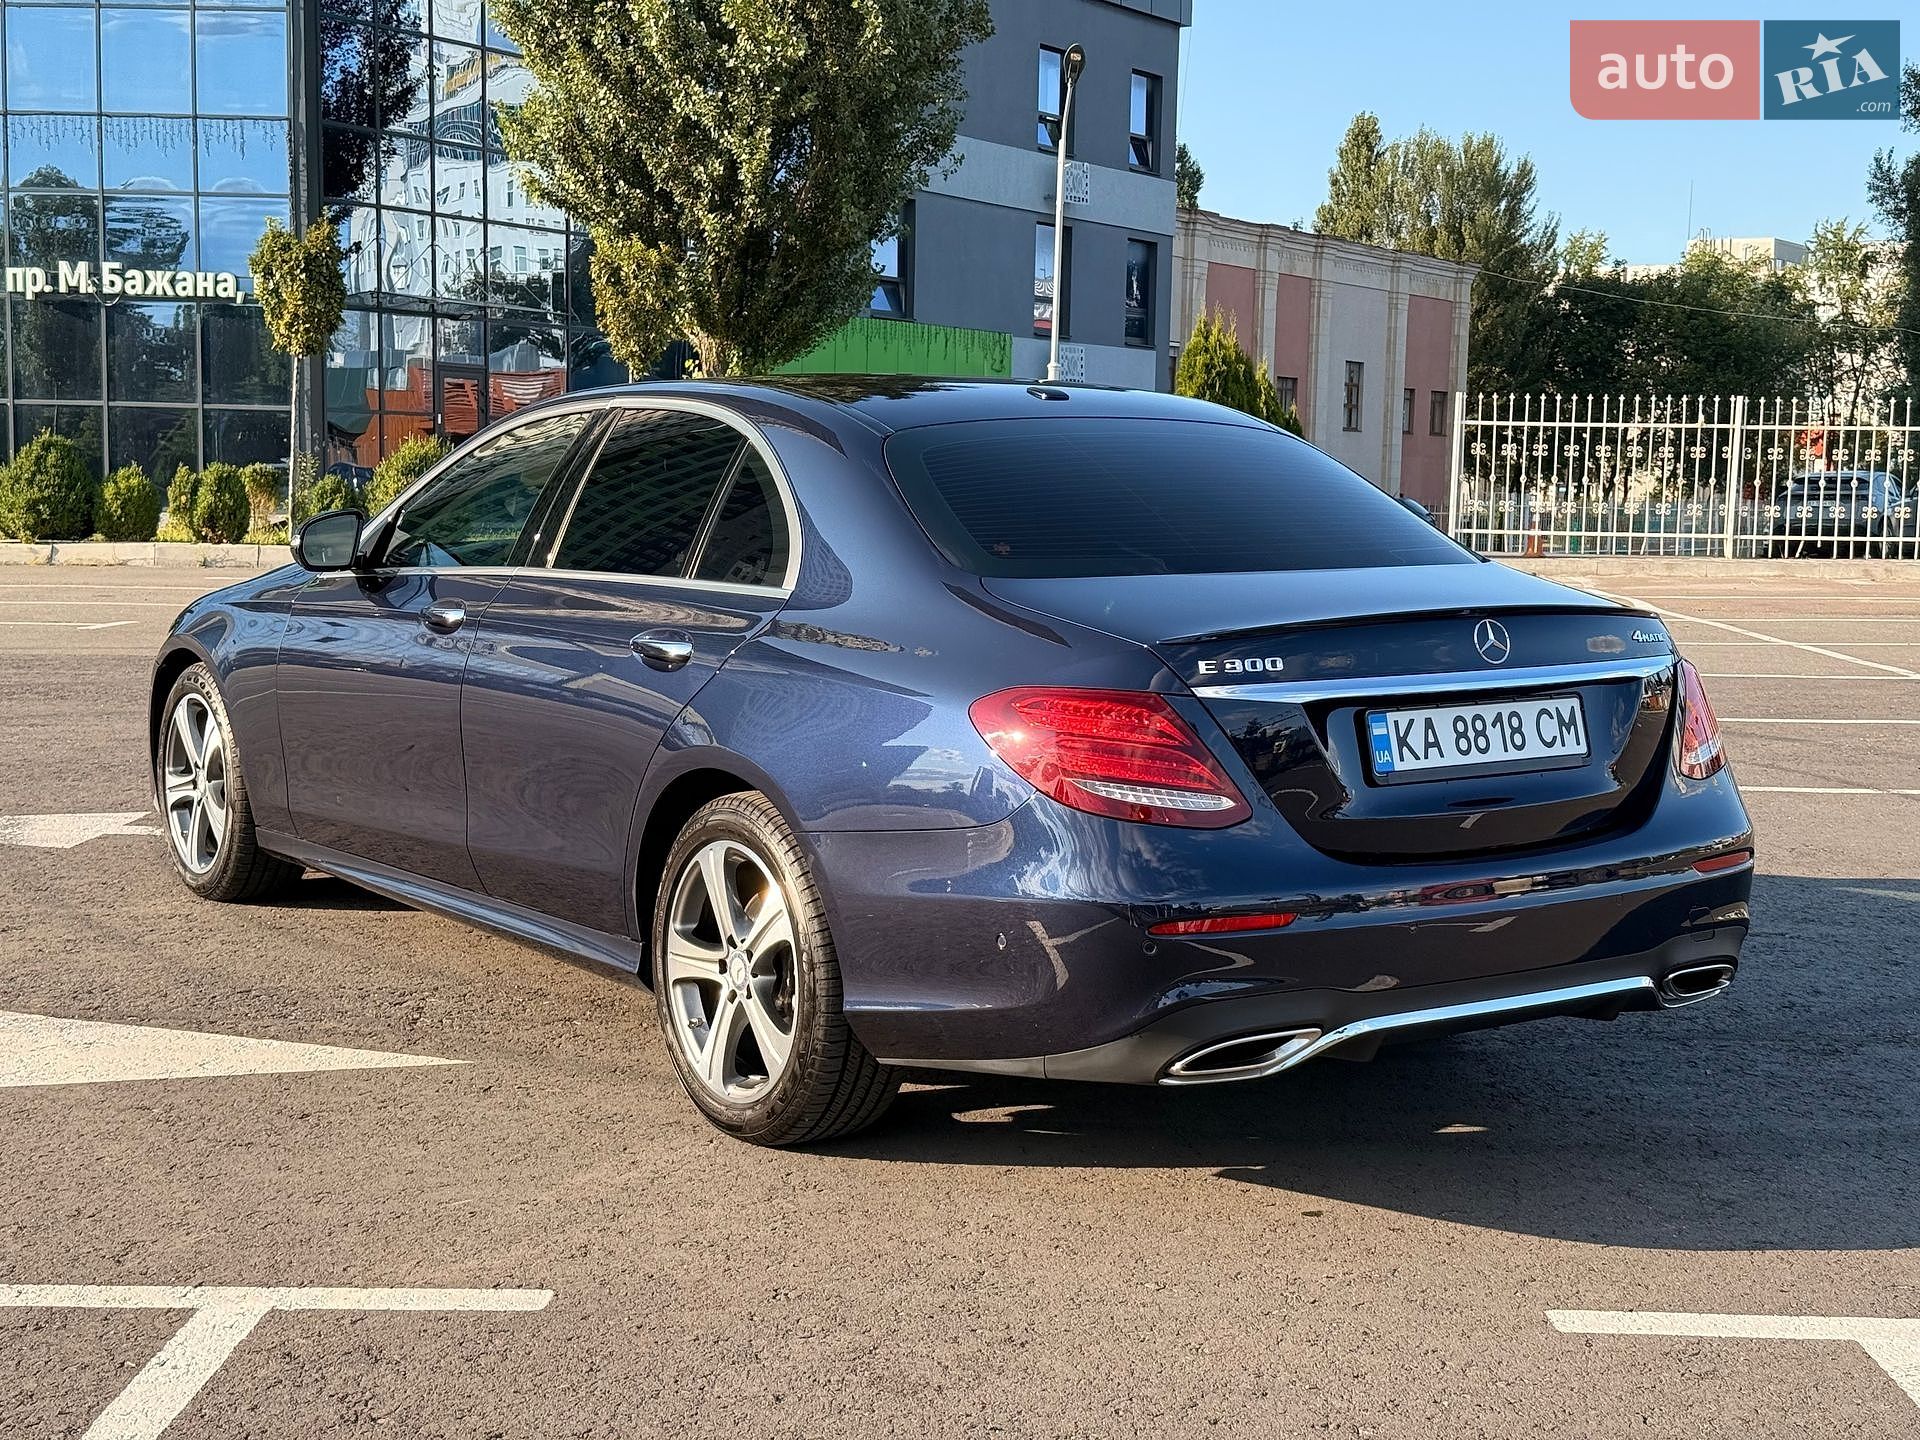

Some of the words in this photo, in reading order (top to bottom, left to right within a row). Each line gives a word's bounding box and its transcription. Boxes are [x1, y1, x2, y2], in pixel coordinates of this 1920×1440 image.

[5, 266, 53, 300] пр.
[102, 261, 246, 304] Бажана,
[1632, 630, 1666, 643] 4MATIC
[1198, 660, 1219, 675] E
[1223, 657, 1284, 673] 300
[1394, 718, 1445, 762] KA
[1452, 711, 1526, 756] 8818
[1536, 705, 1581, 748] CM
[1375, 749, 1392, 764] UA
